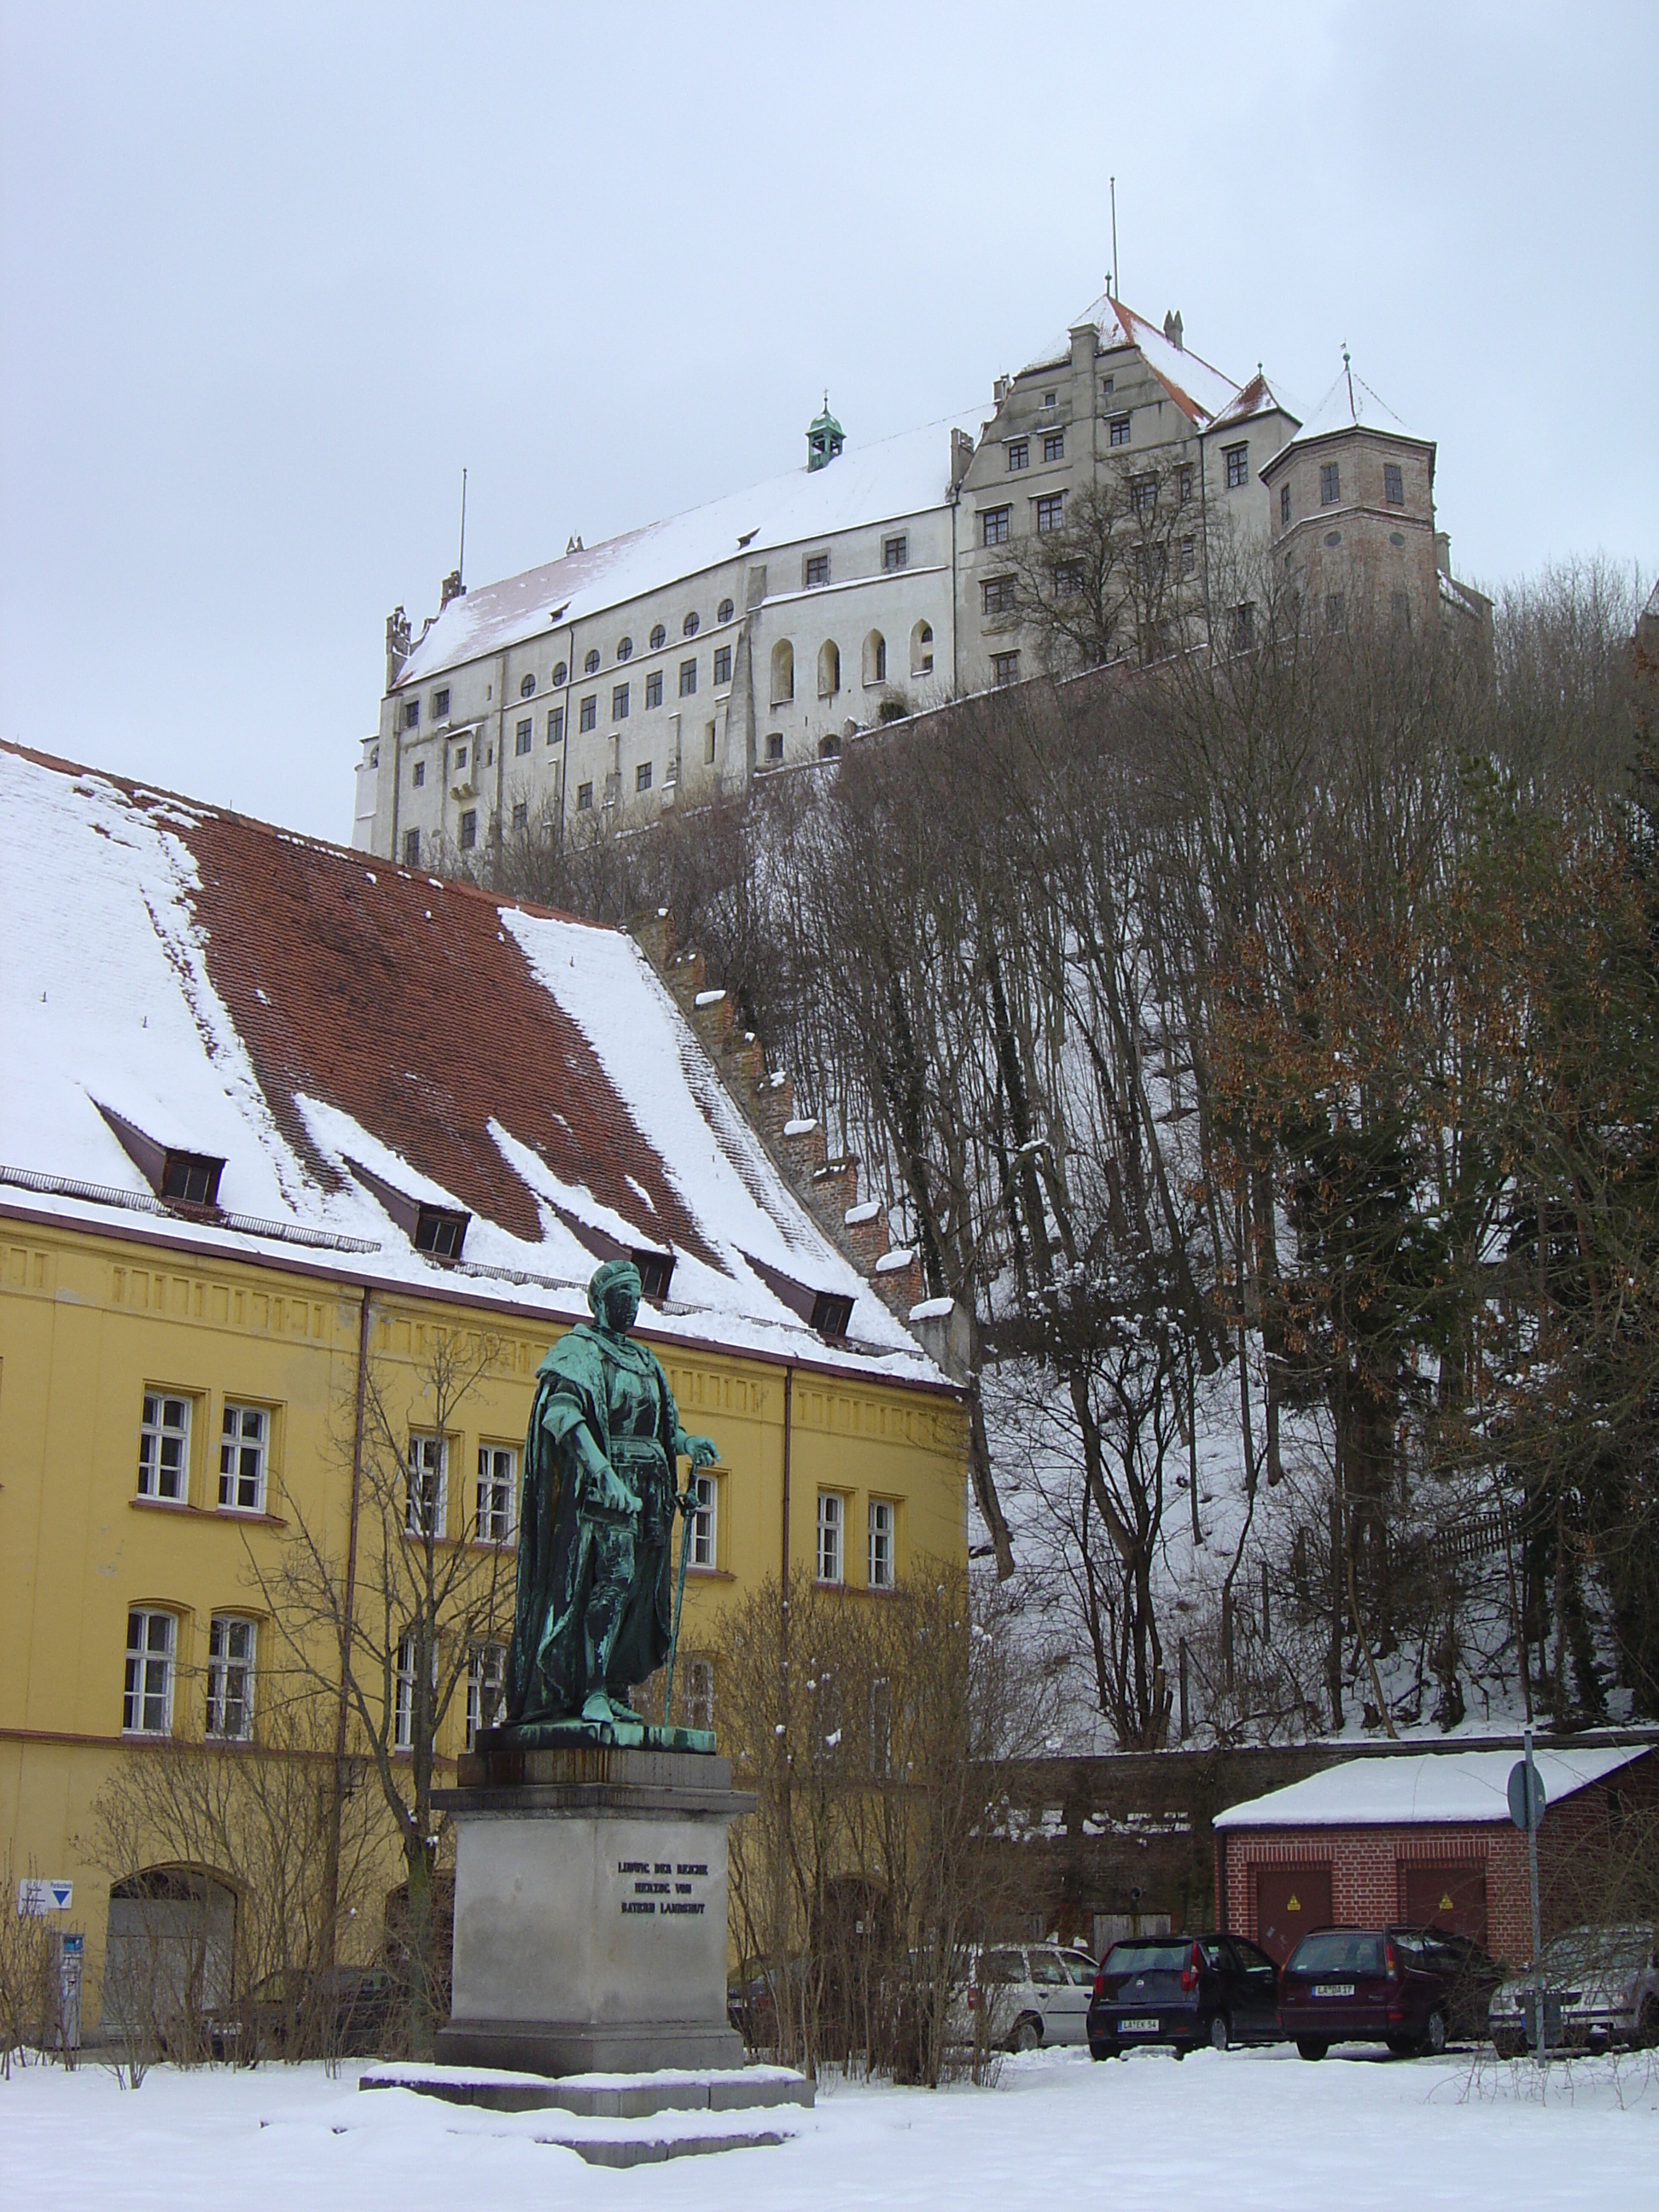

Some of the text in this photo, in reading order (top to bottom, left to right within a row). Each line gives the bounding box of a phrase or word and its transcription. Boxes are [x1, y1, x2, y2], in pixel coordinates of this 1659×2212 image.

[655, 1863, 672, 1875] DER
[677, 1864, 707, 1875] REICHE
[635, 1883, 691, 1894] HERZOG VON
[621, 1902, 705, 1914] BAYERN LANDSHUT
